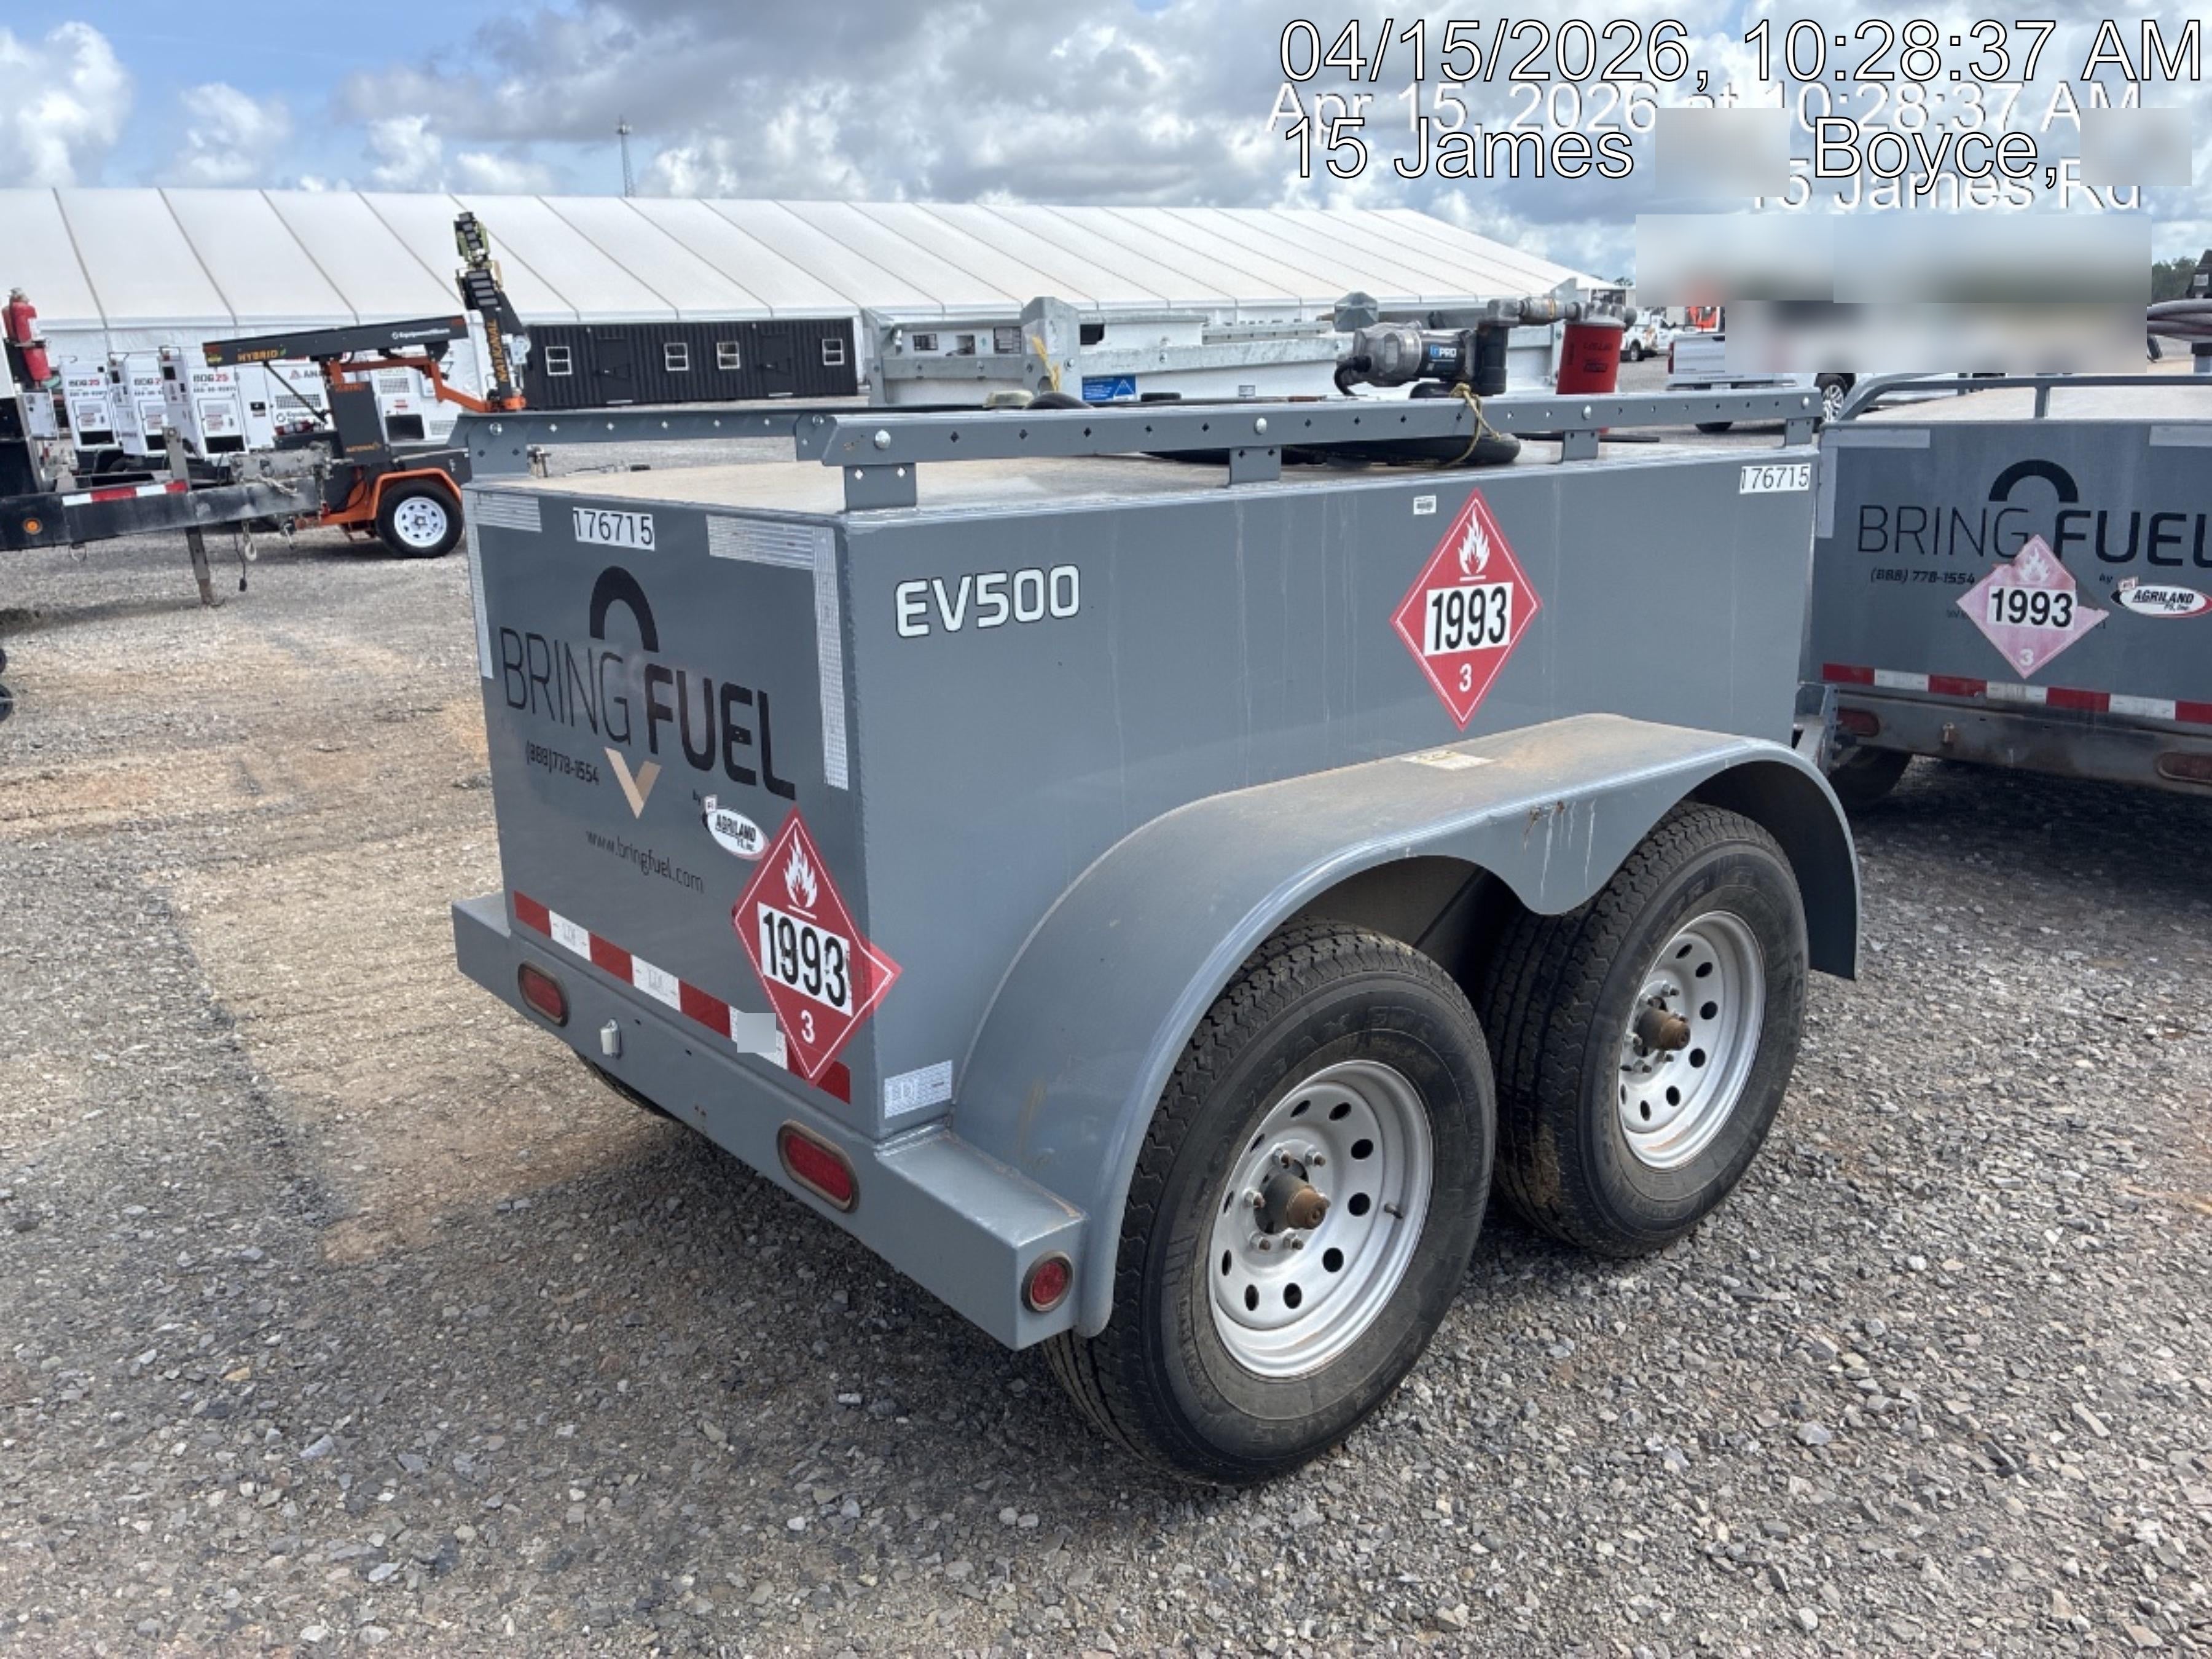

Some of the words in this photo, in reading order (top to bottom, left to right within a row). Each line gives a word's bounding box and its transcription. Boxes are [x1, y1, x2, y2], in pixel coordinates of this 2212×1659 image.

[238, 350, 278, 362] HYBRID
[1741, 466, 1809, 490] 176715
[574, 511, 653, 546] 176715
[1857, 505, 2029, 559] BRING
[895, 563, 1080, 638] EV500
[1432, 586, 1507, 651] 1993
[1991, 587, 2073, 628] 1993
[1459, 663, 1472, 692] 3
[2019, 648, 2034, 666] 3
[500, 626, 631, 745] BRING
[644, 664, 796, 801] FUEL
[586, 831, 705, 892] www.bringfuel.com
[763, 912, 845, 1007] 1993
[801, 1010, 815, 1043] 3
